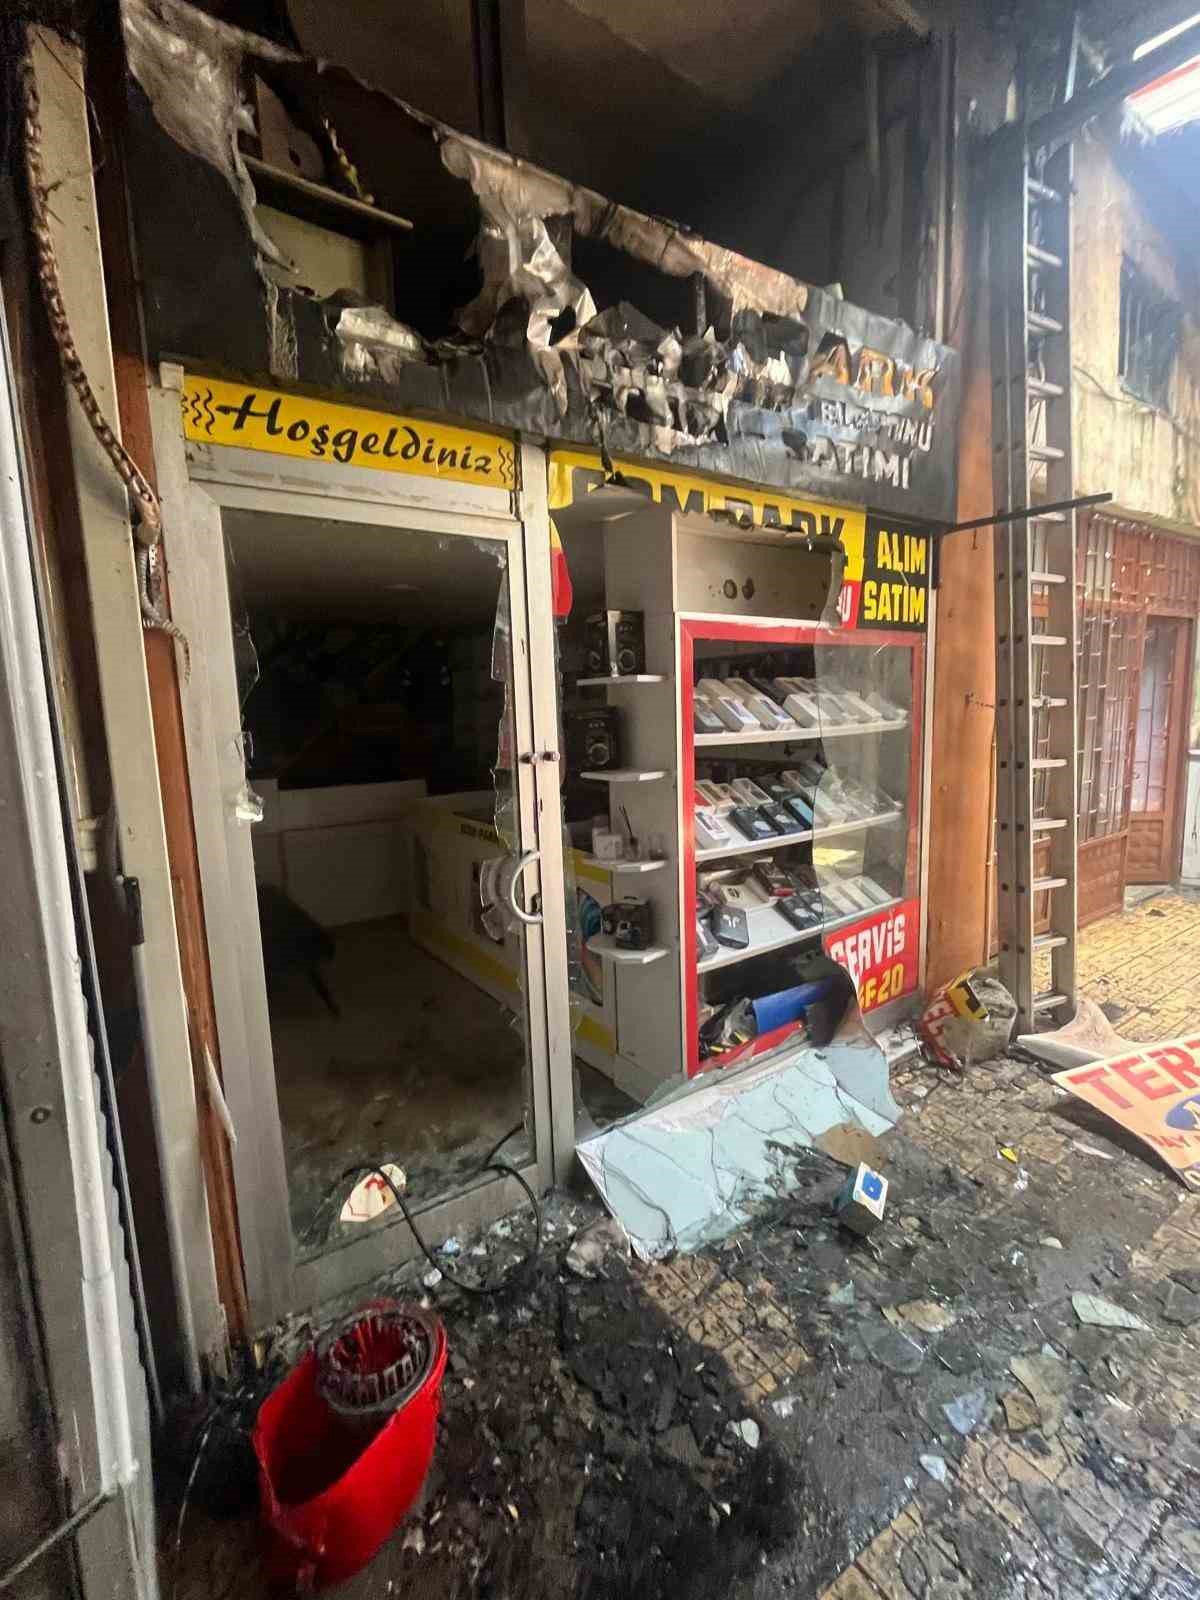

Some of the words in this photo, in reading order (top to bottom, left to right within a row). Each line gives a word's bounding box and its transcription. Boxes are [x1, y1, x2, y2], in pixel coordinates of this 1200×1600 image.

[216, 393, 492, 474] Hoşgeldiniz
[877, 530, 927, 575] ALIM
[863, 580, 926, 625] SATIM
[1066, 1038, 1200, 1110] TER
